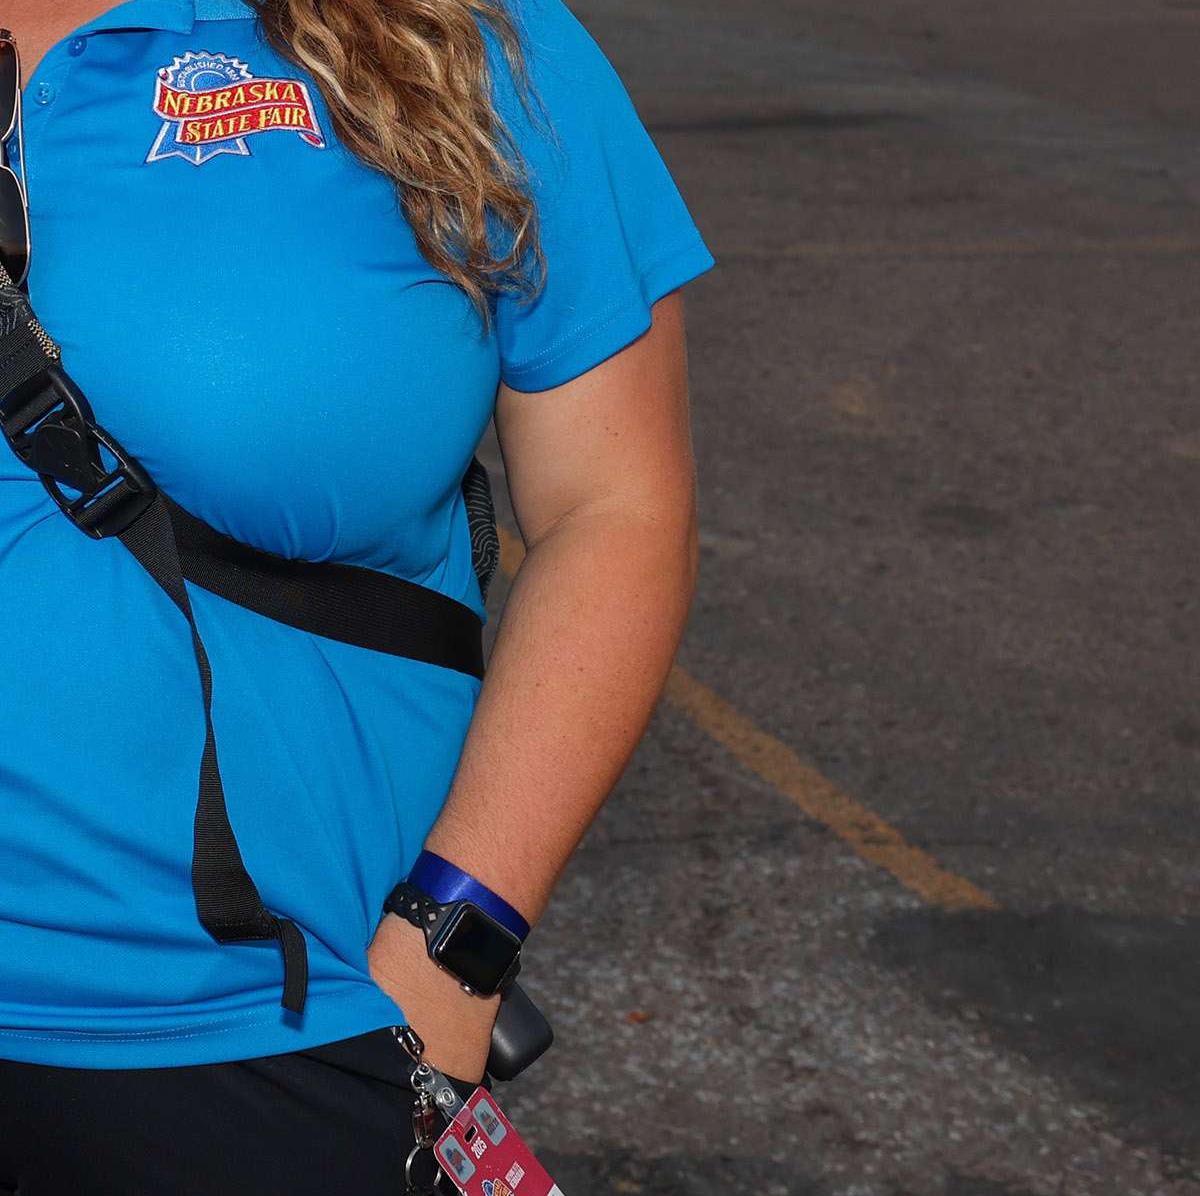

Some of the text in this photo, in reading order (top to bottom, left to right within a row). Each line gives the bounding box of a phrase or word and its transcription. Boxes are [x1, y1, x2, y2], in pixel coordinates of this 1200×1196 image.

[163, 82, 298, 115] NEBRASKA
[185, 106, 307, 142] STATE FAIR
